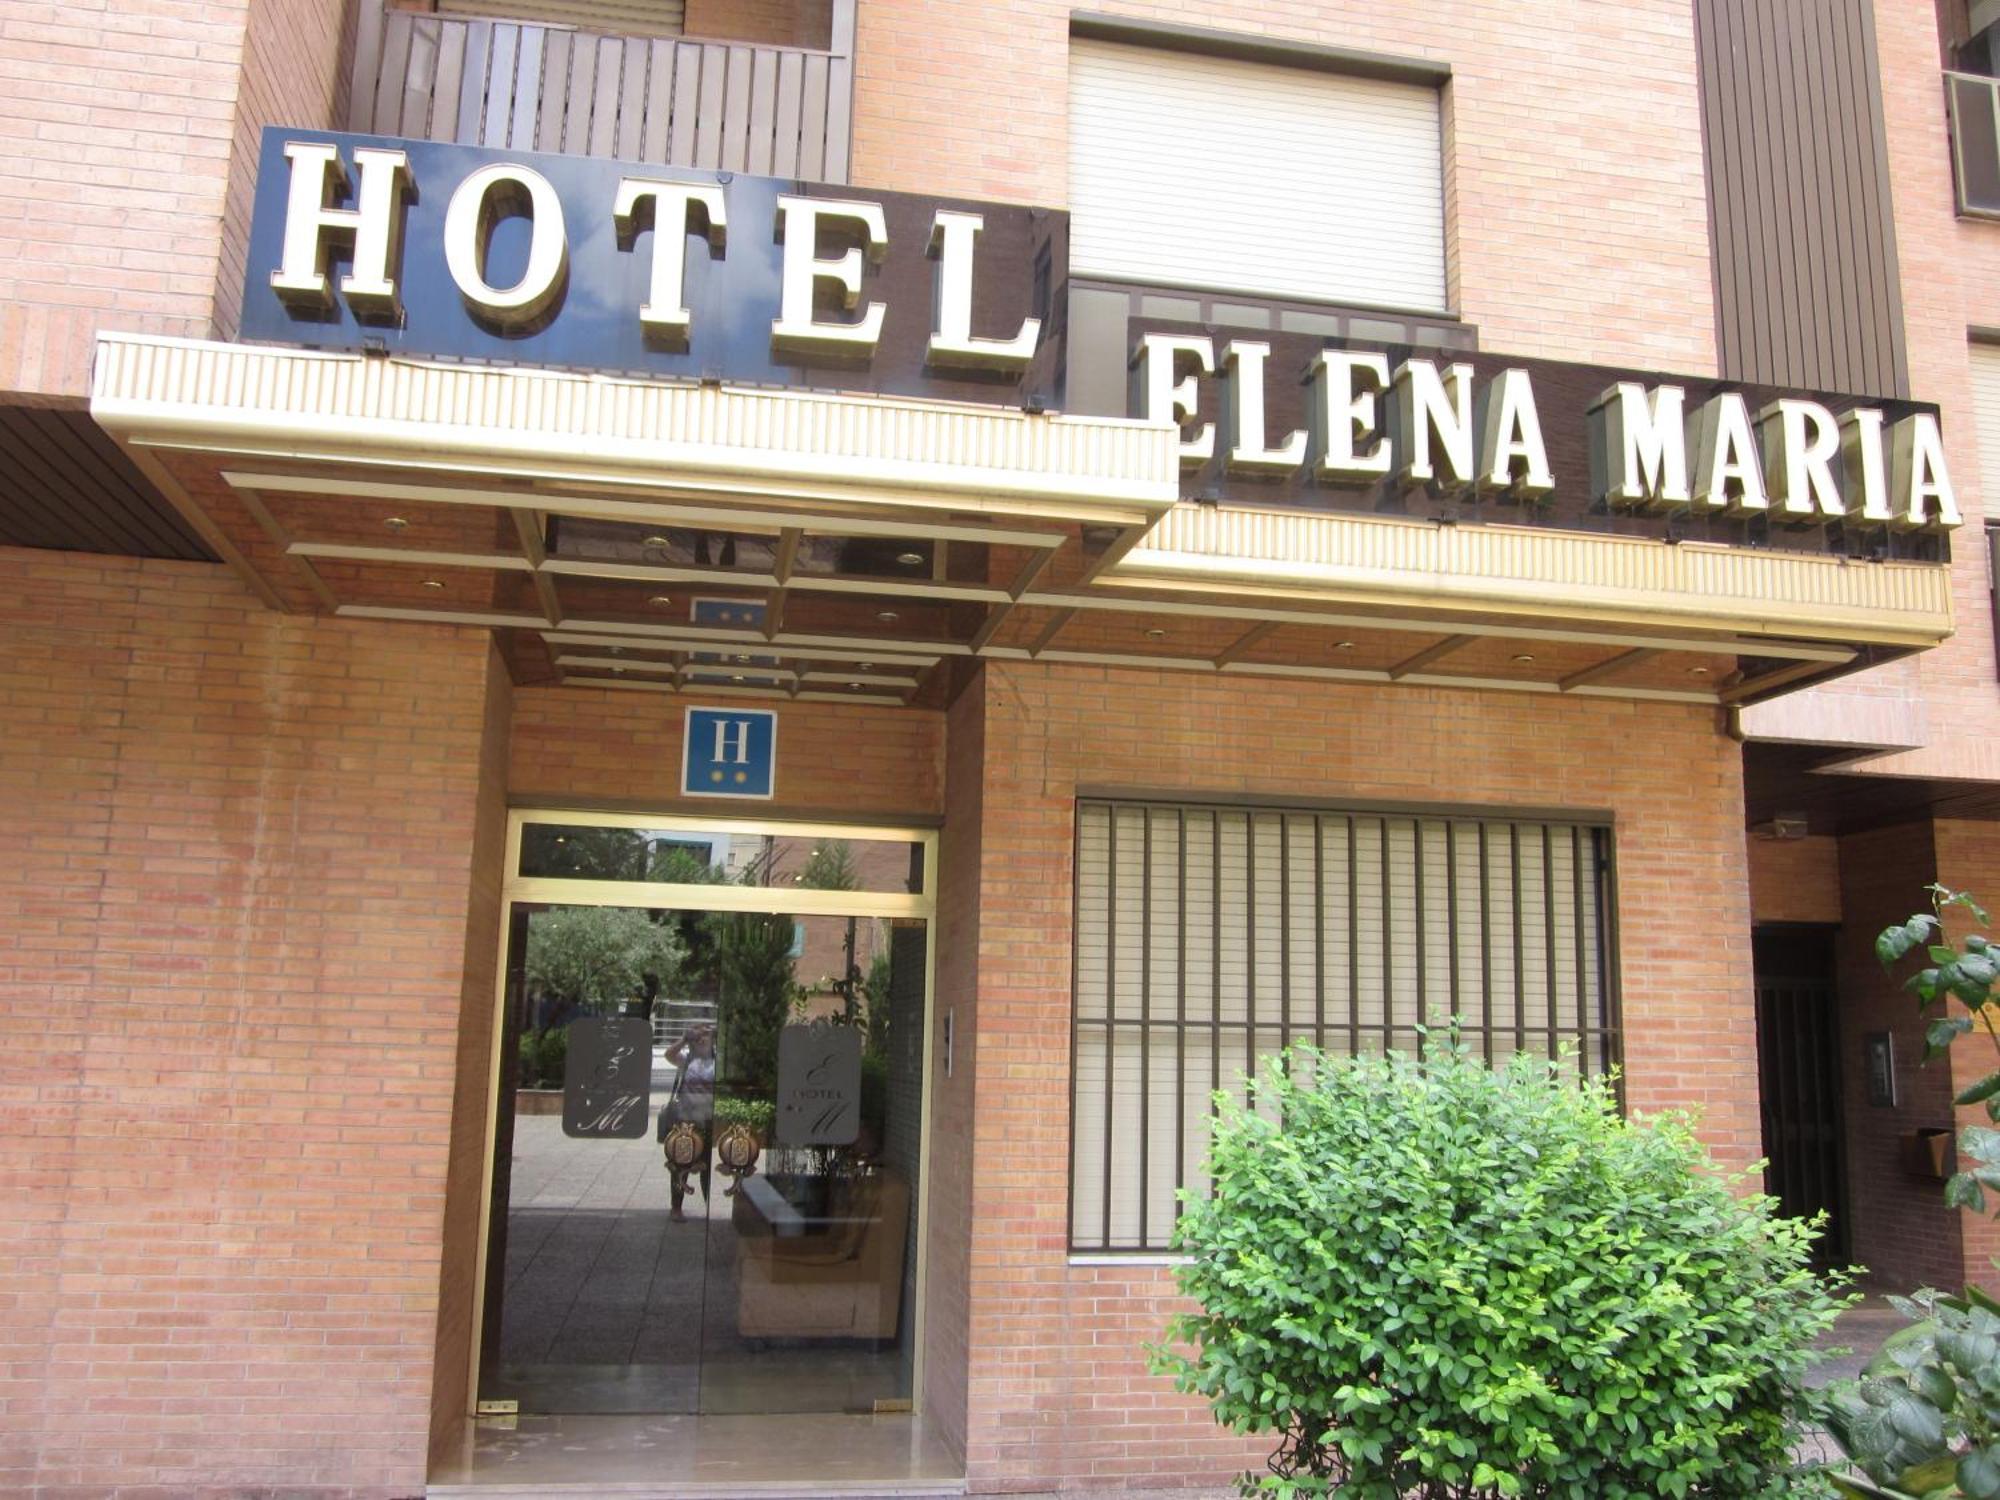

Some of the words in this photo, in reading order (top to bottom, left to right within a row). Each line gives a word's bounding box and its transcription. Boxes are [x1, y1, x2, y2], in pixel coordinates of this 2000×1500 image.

[268, 140, 1042, 368] HOTEL
[1140, 332, 1556, 490] ELENA
[1600, 381, 1963, 528] MARIA
[709, 719, 752, 764] H
